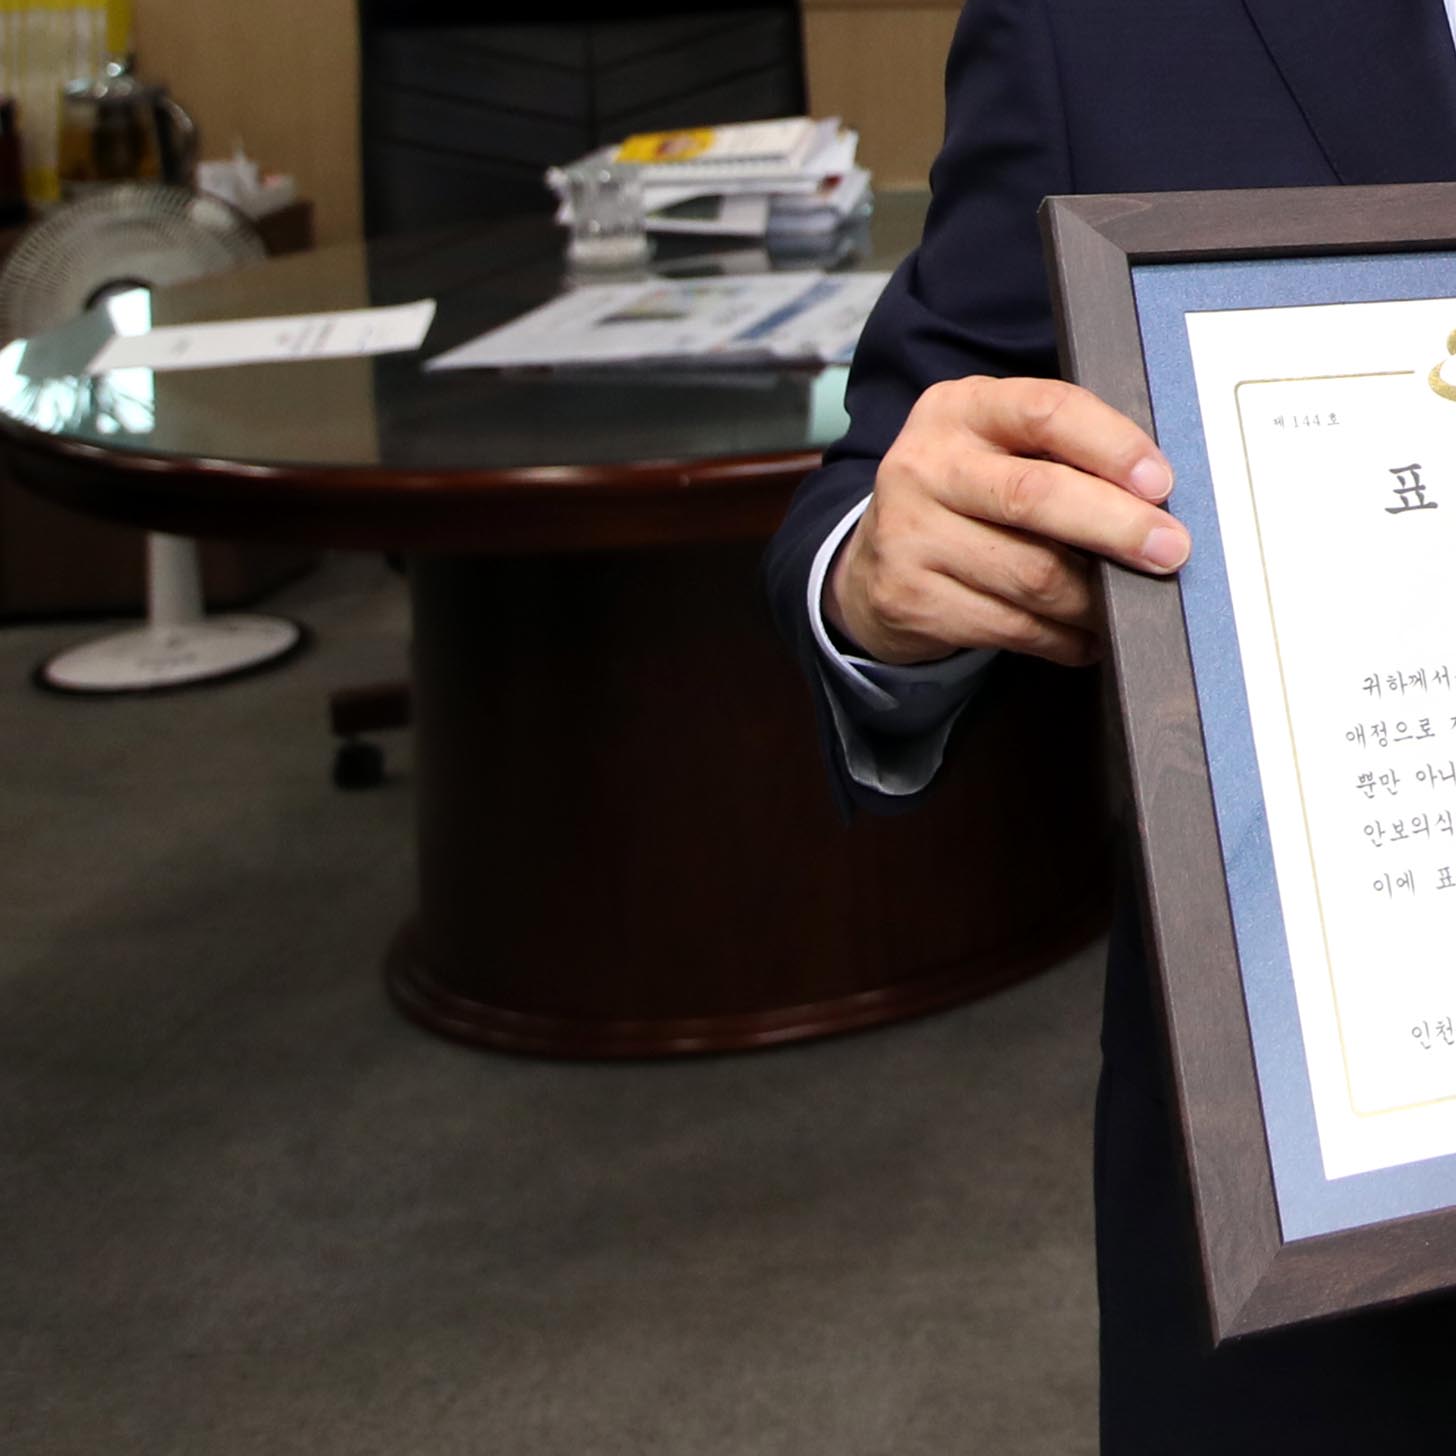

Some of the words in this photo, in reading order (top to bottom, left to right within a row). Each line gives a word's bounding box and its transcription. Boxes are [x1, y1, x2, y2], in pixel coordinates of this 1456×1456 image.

[1345, 717, 1436, 748] 애정으로
[1356, 768, 1401, 800] 뿐만
[1363, 810, 1454, 848] 안보의식
[1372, 869, 1415, 896] 이에
